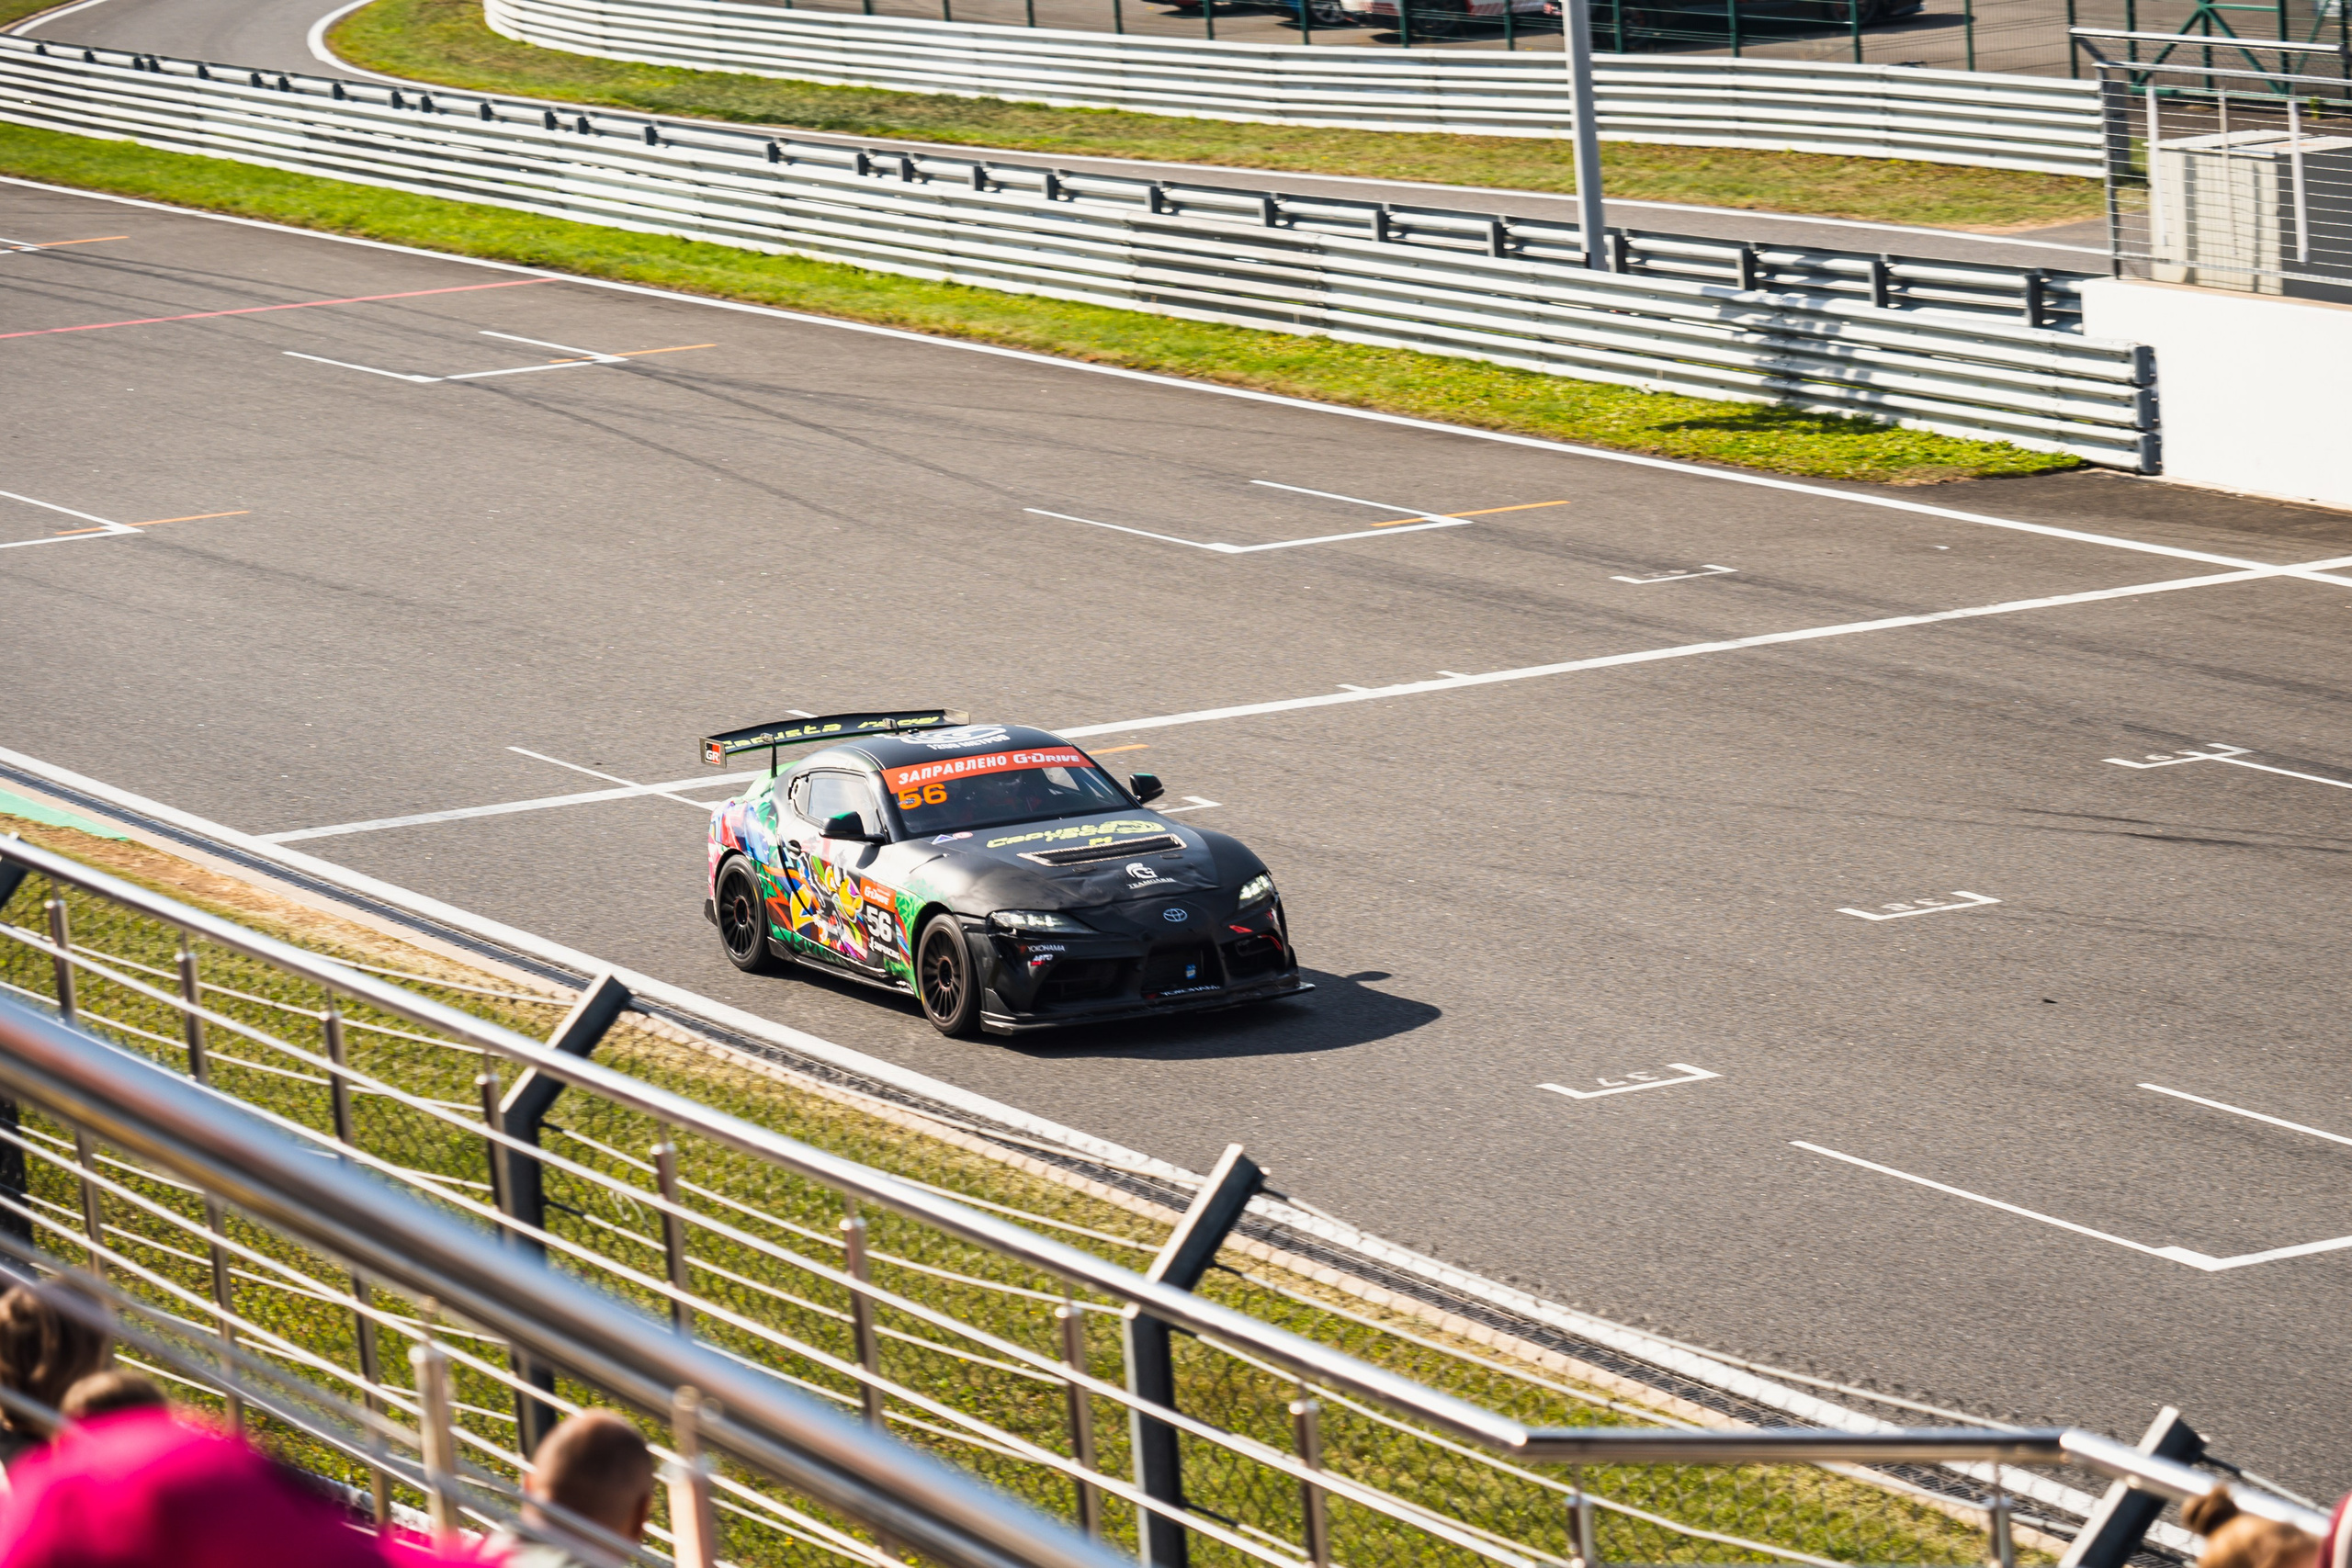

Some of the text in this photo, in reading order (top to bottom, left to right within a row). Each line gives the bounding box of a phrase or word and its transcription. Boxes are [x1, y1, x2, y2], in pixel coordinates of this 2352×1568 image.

[706, 750, 720, 762] GR
[898, 755, 1007, 785] ЗАПРАВЛЕНО
[897, 783, 948, 810] 56
[865, 905, 892, 942] 56
[1027, 943, 1066, 953] YOKOHAMA
